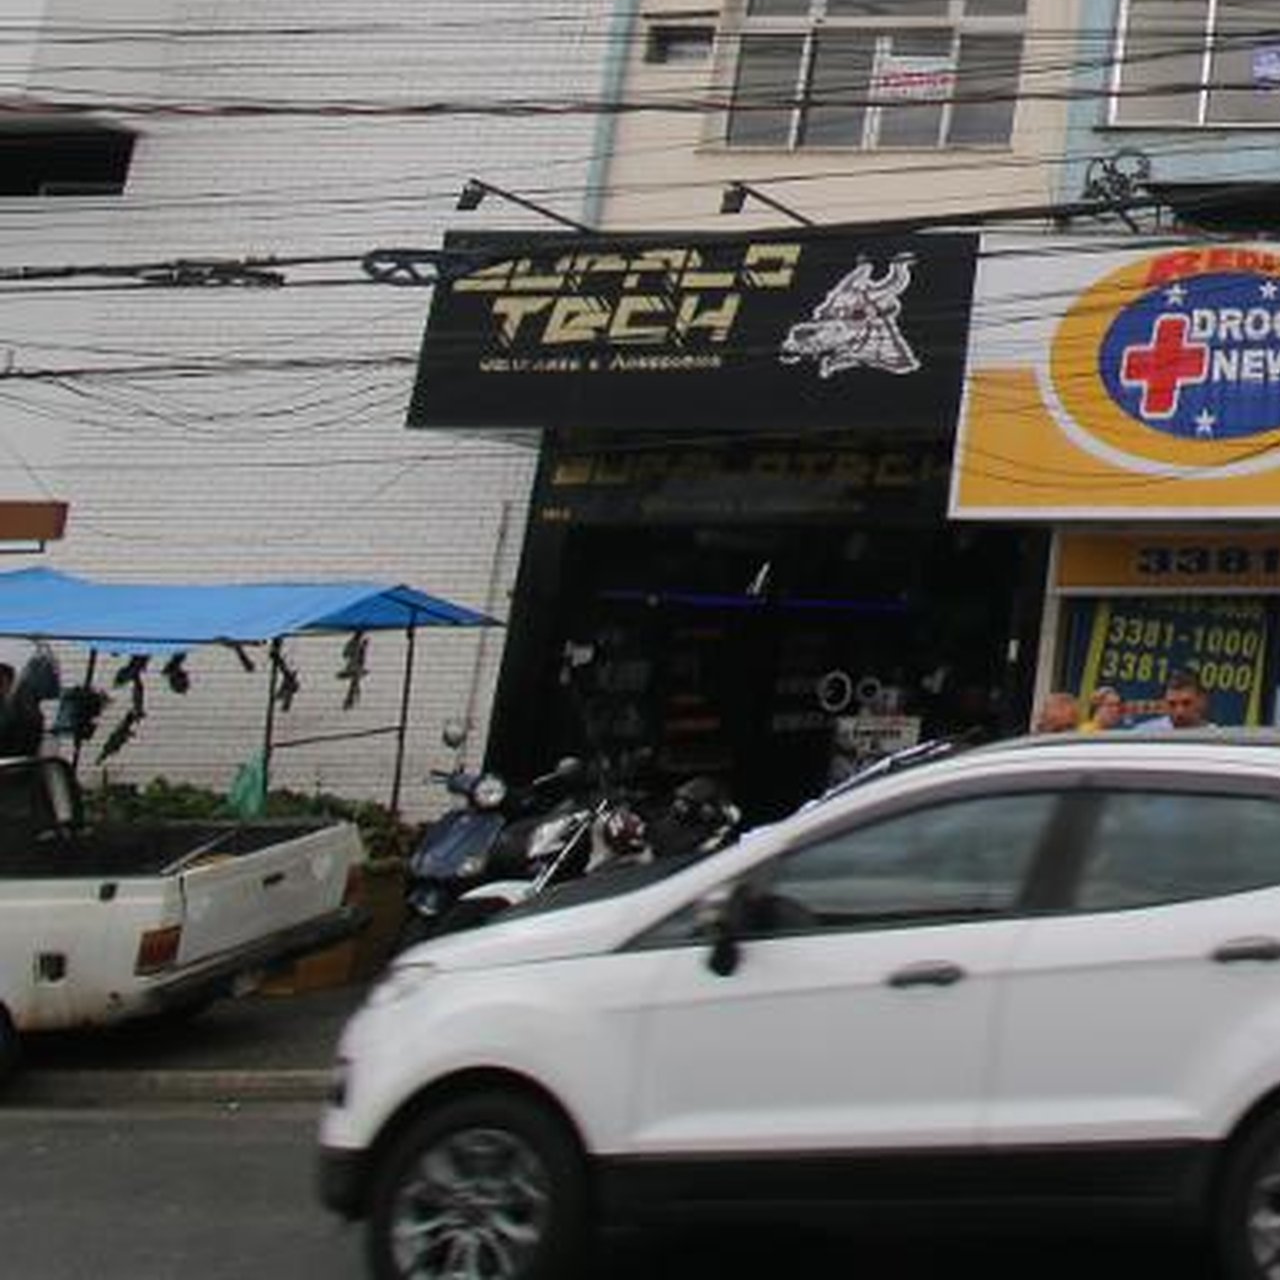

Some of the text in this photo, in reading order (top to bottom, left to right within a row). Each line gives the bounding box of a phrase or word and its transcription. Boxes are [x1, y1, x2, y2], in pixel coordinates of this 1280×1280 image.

[492, 292, 742, 345] TECH
[1109, 616, 1259, 657] 3381-1000
[1101, 651, 1252, 692] 3381000
